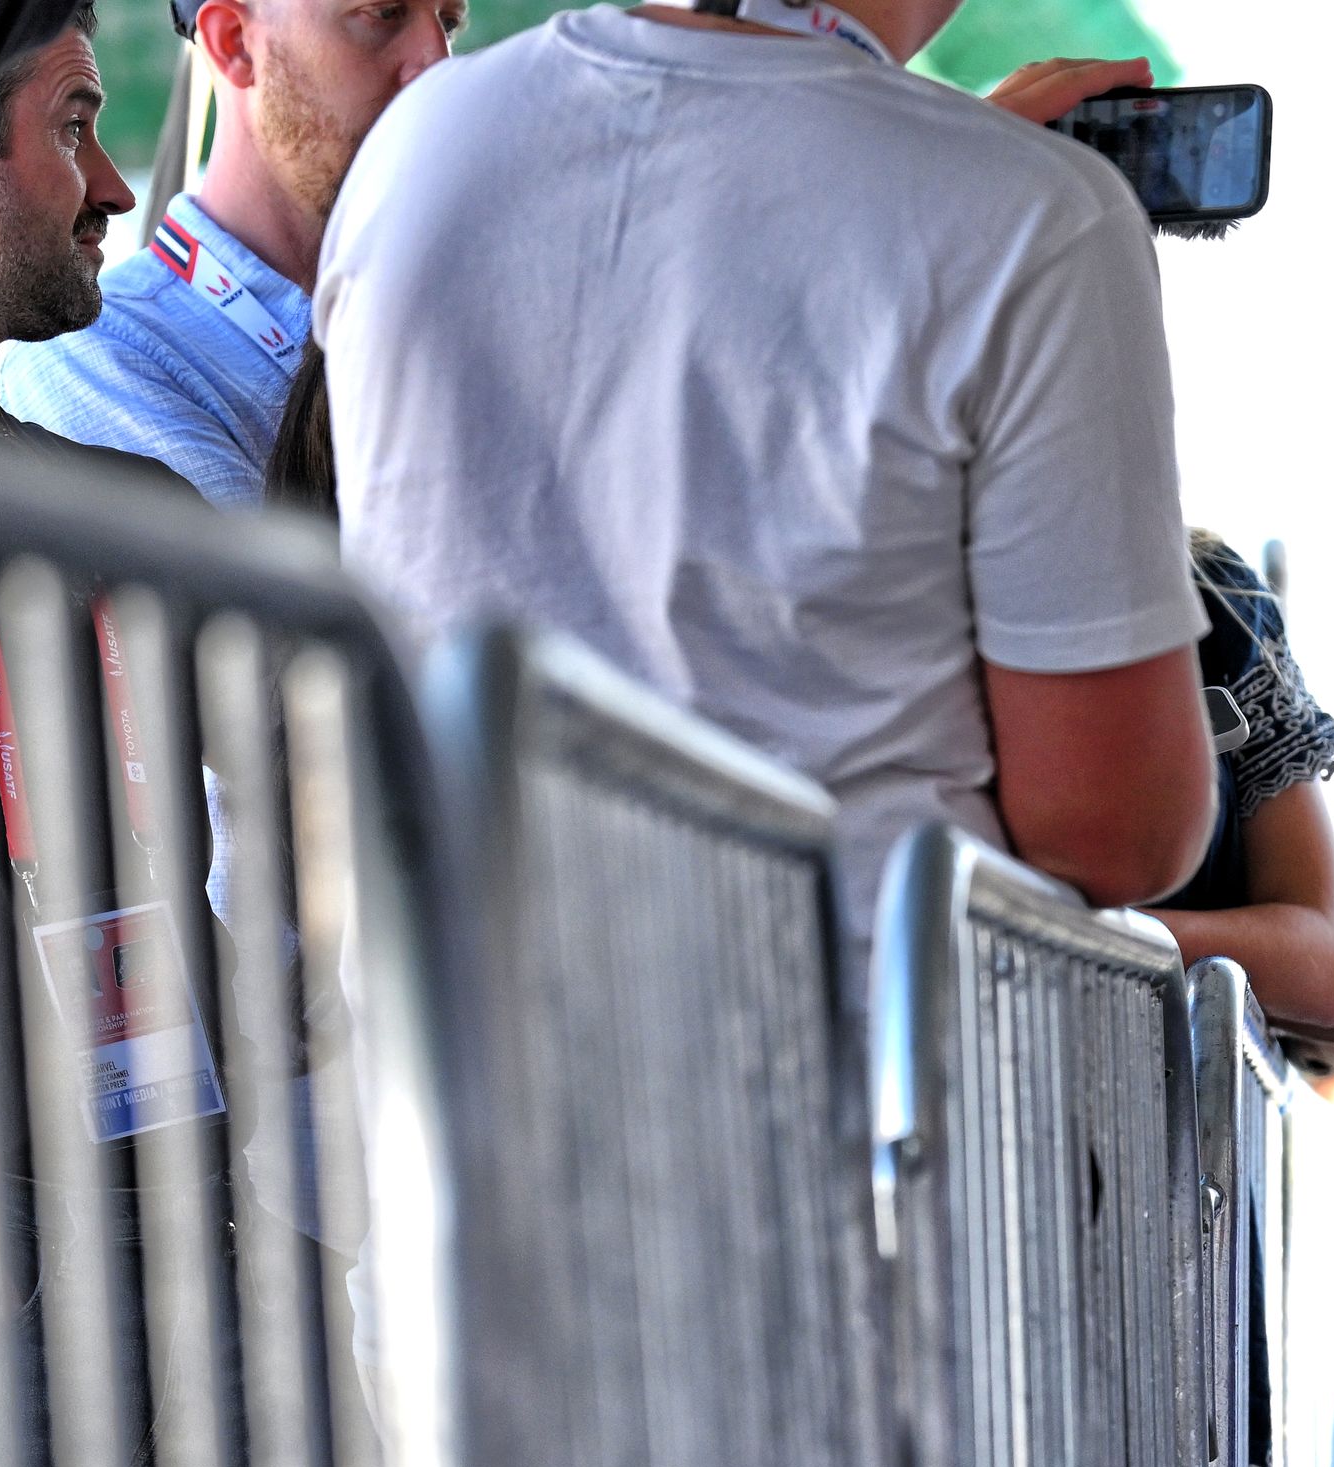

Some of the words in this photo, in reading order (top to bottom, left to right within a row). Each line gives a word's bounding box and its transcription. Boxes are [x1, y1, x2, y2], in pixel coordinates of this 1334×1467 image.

[121, 708, 136, 757] TOYOTA
[0, 752, 17, 800] USATF
[107, 1069, 130, 1083] CHANNEL
[110, 1079, 127, 1090] PRESS
[123, 1086, 157, 1107] MEDIA
